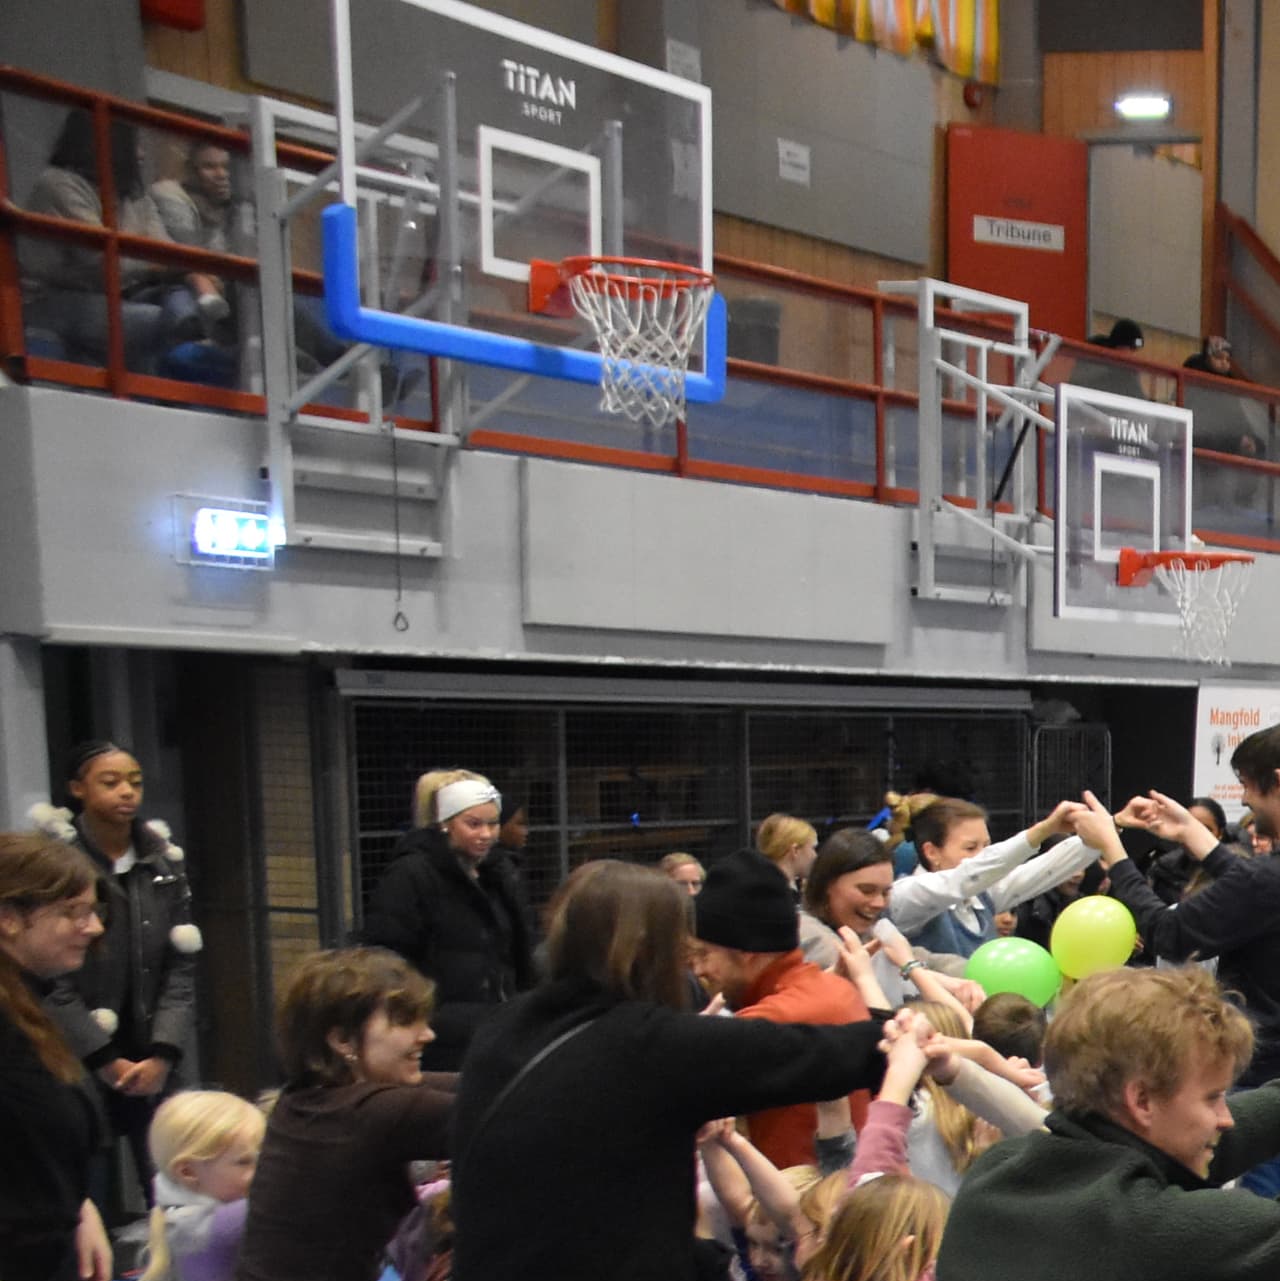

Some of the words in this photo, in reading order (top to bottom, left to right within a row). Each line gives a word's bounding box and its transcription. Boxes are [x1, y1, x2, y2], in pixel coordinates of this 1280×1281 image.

[522, 102, 562, 126] SPORT
[985, 219, 1052, 242] Tribune
[1209, 706, 1260, 730] Mangfold
